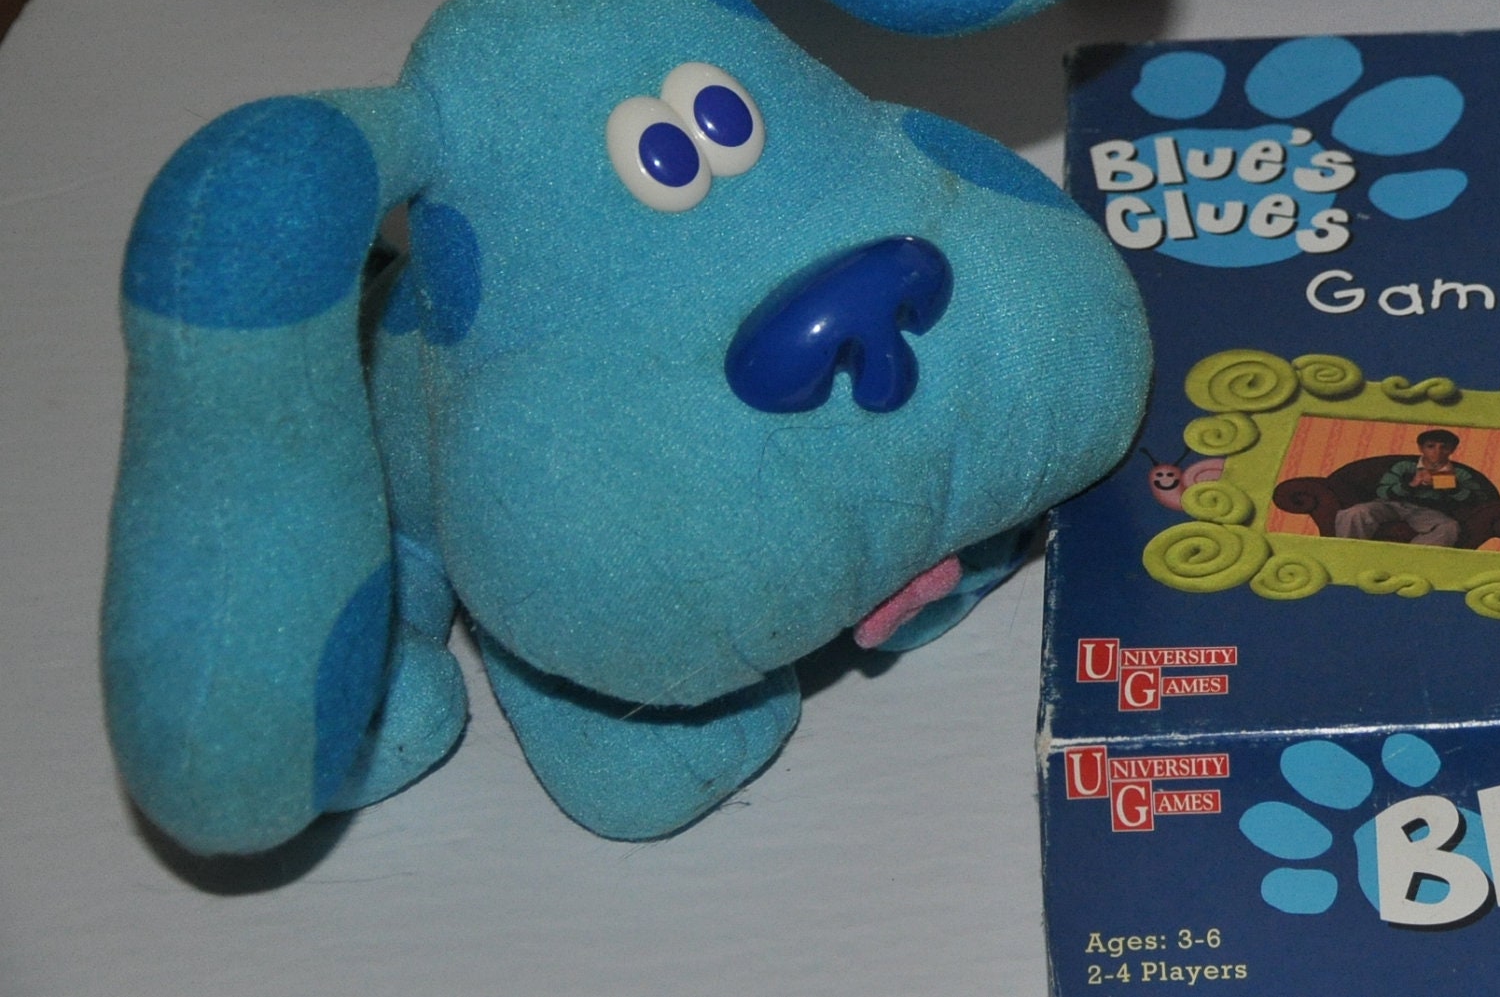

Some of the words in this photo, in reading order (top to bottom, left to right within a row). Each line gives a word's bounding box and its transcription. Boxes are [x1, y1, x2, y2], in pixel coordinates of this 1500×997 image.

[1089, 128, 1356, 193] Blue's
[1105, 190, 1351, 254] Clues
[1083, 643, 1233, 679] UNIVERSITY
[1124, 671, 1221, 707] GAMES
[1069, 752, 1225, 796] UNIVERSITY
[1116, 784, 1214, 827] GAMES
[1085, 932, 1166, 958] Ages:
[1178, 928, 1221, 949] 3-6
[1088, 962, 1131, 985] 2-4
[1141, 961, 1248, 986] Players
